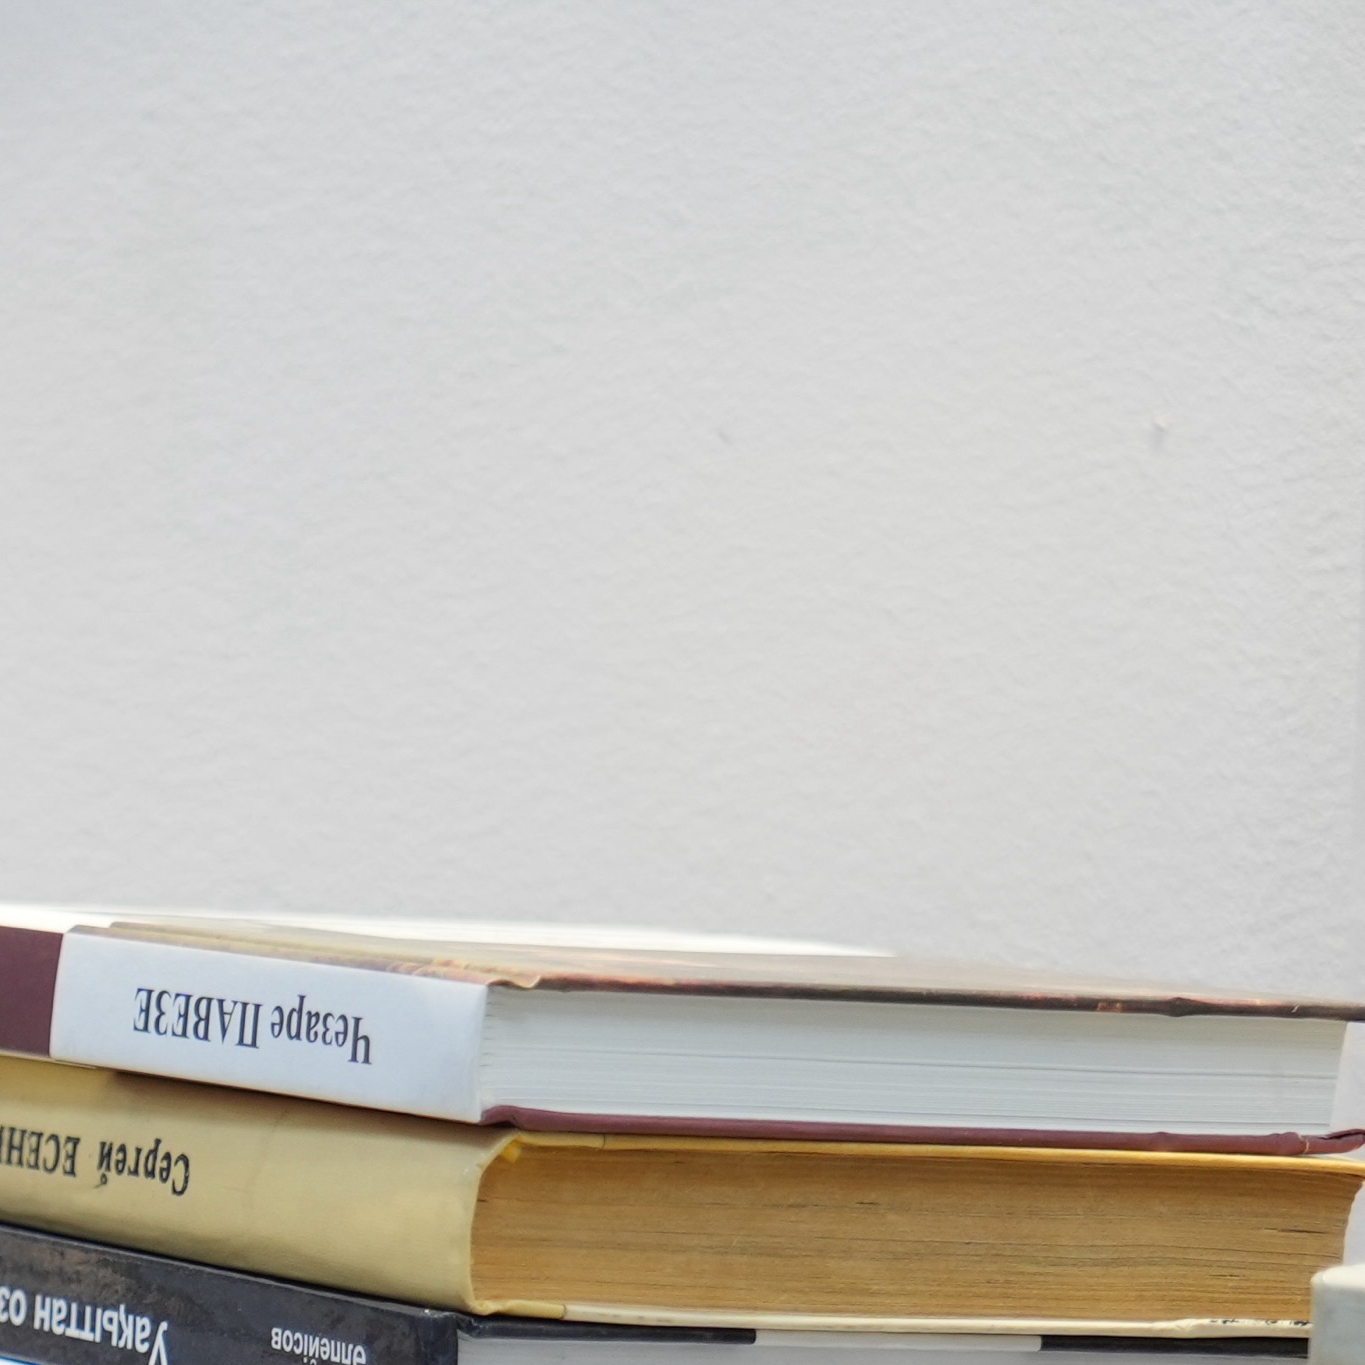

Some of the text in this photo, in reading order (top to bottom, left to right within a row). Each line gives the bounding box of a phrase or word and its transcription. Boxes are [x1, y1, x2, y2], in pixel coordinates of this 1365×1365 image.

[133, 986, 373, 1067] Чезаре ПАВЕЗЕ
[96, 1136, 191, 1197] Сергей
